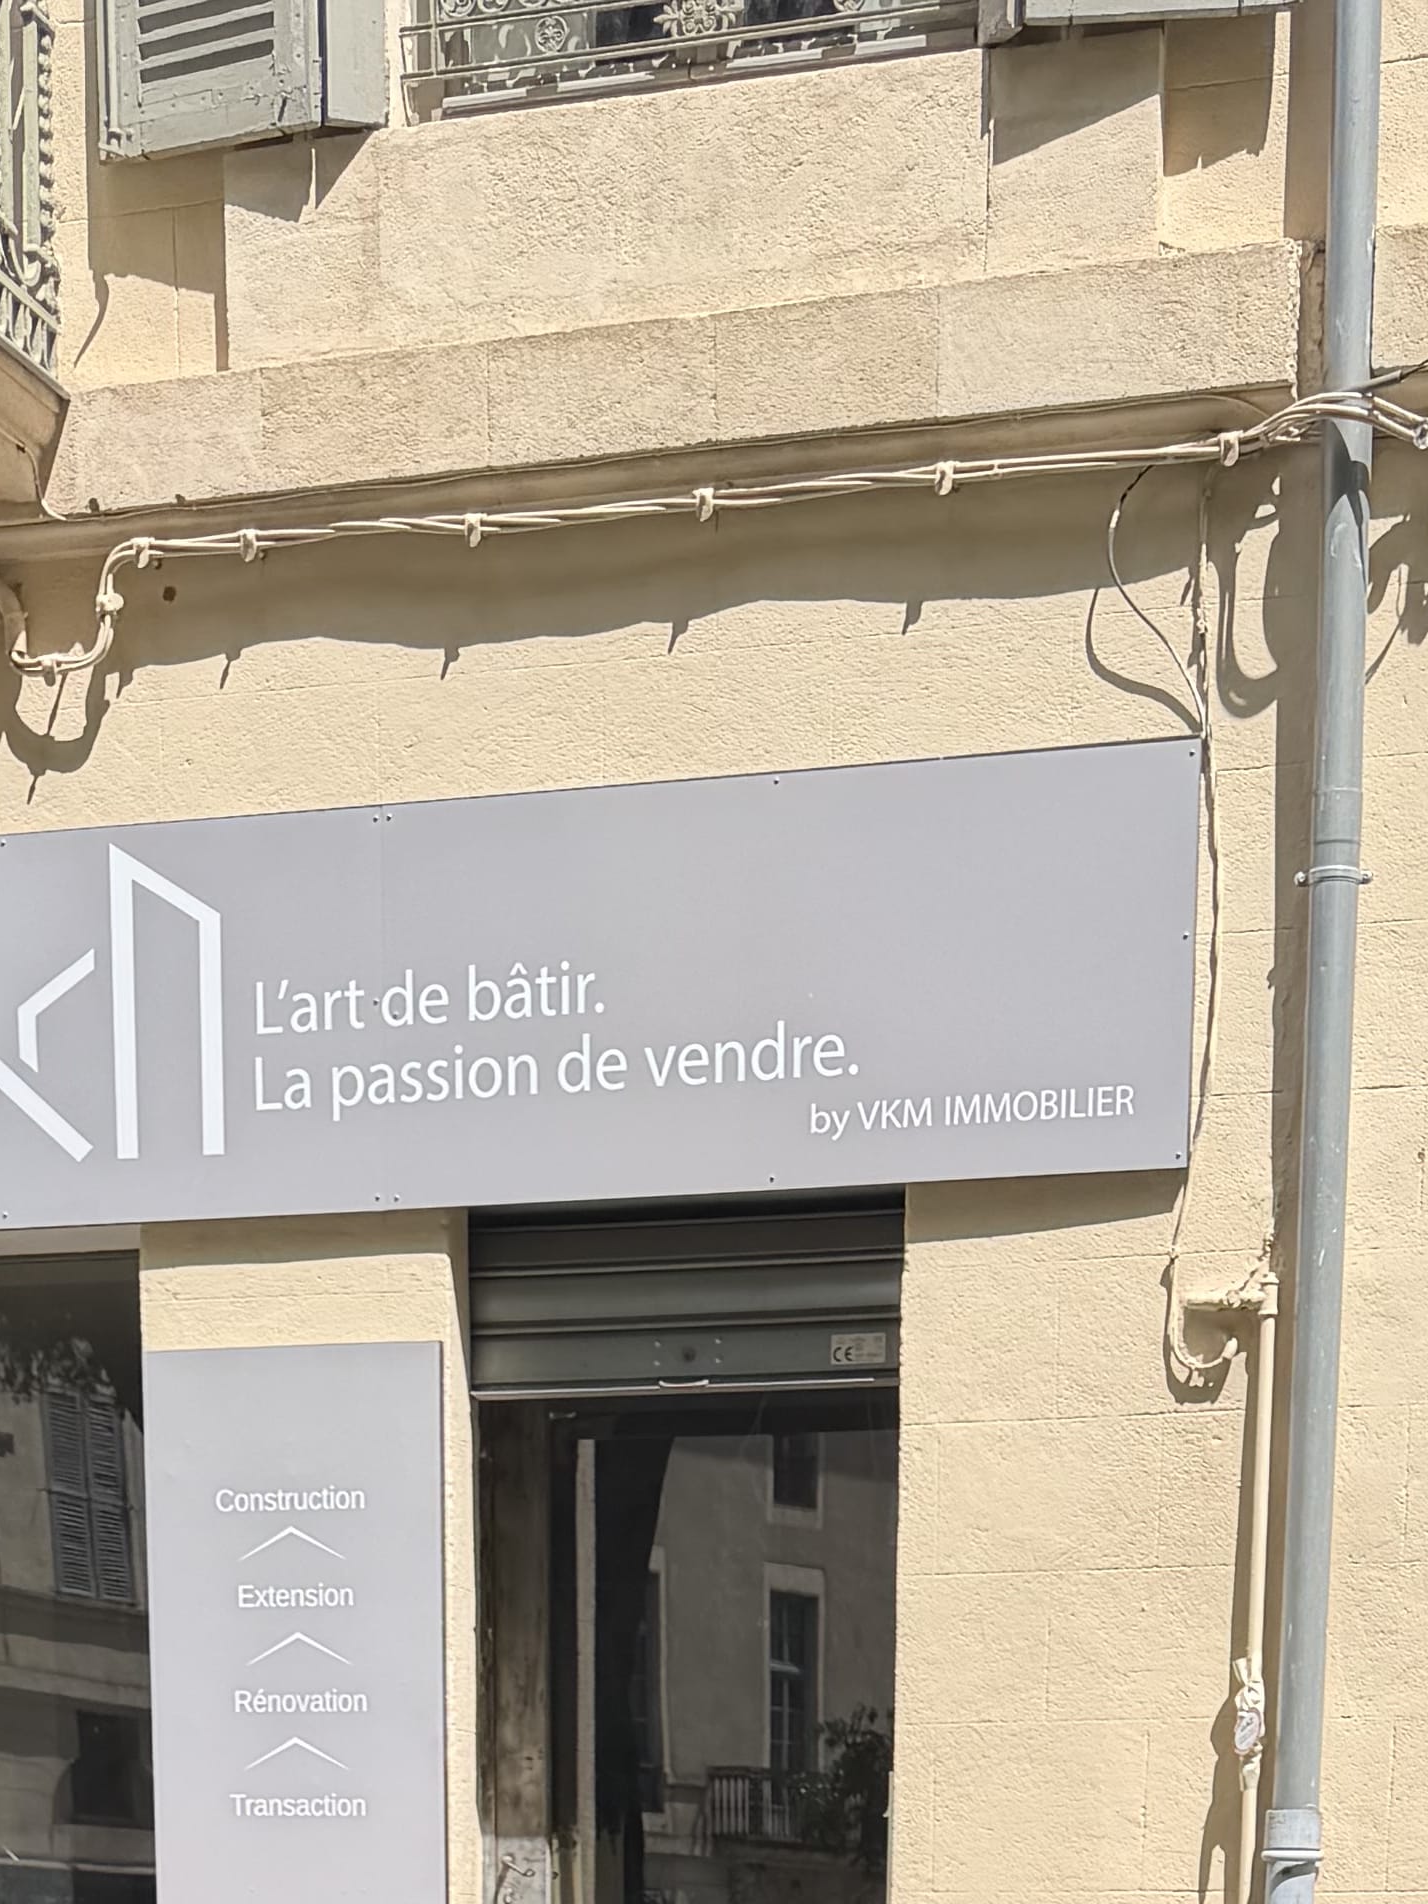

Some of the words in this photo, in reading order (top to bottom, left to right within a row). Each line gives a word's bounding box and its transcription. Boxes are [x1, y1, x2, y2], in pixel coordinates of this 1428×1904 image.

[256, 979, 365, 1034] L'art
[381, 969, 450, 1027] de
[468, 961, 605, 1022] bâtir.
[255, 1056, 312, 1111] La
[331, 1044, 539, 1122] passion
[557, 1033, 628, 1093] de
[644, 1020, 859, 1087] vendre.
[810, 1103, 850, 1141] by
[857, 1097, 933, 1130] VKM
[944, 1085, 1135, 1126] IMMOBILIER
[833, 1346, 853, 1362] CE
[215, 1485, 366, 1512] Construction
[238, 1583, 355, 1608] Extension
[234, 1688, 368, 1713] Rénovation
[230, 1793, 367, 1817] Transaction
